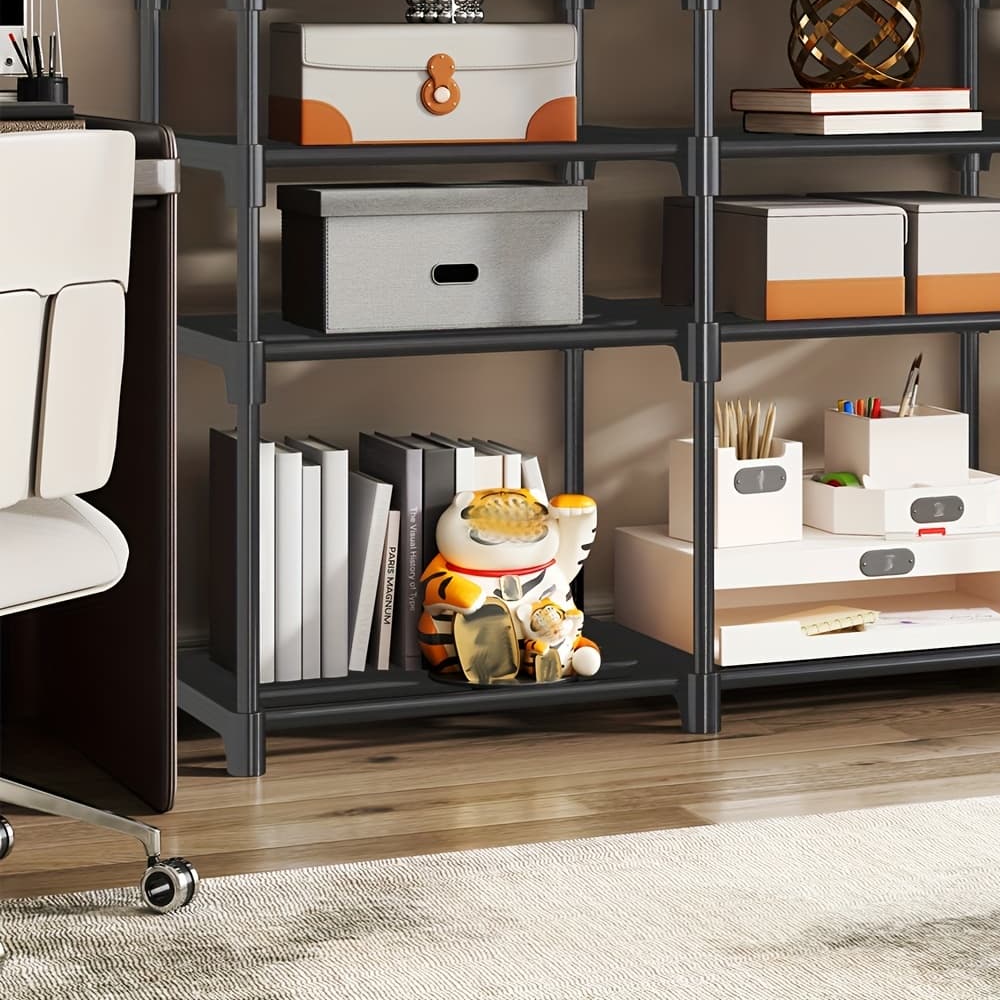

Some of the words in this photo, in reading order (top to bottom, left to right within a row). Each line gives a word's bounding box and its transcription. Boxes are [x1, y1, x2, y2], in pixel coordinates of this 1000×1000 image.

[409, 507, 418, 523] The
[409, 524, 418, 549] Visual
[386, 546, 397, 574] PARIS
[408, 551, 417, 580] History
[383, 576, 396, 625] MAGNUM
